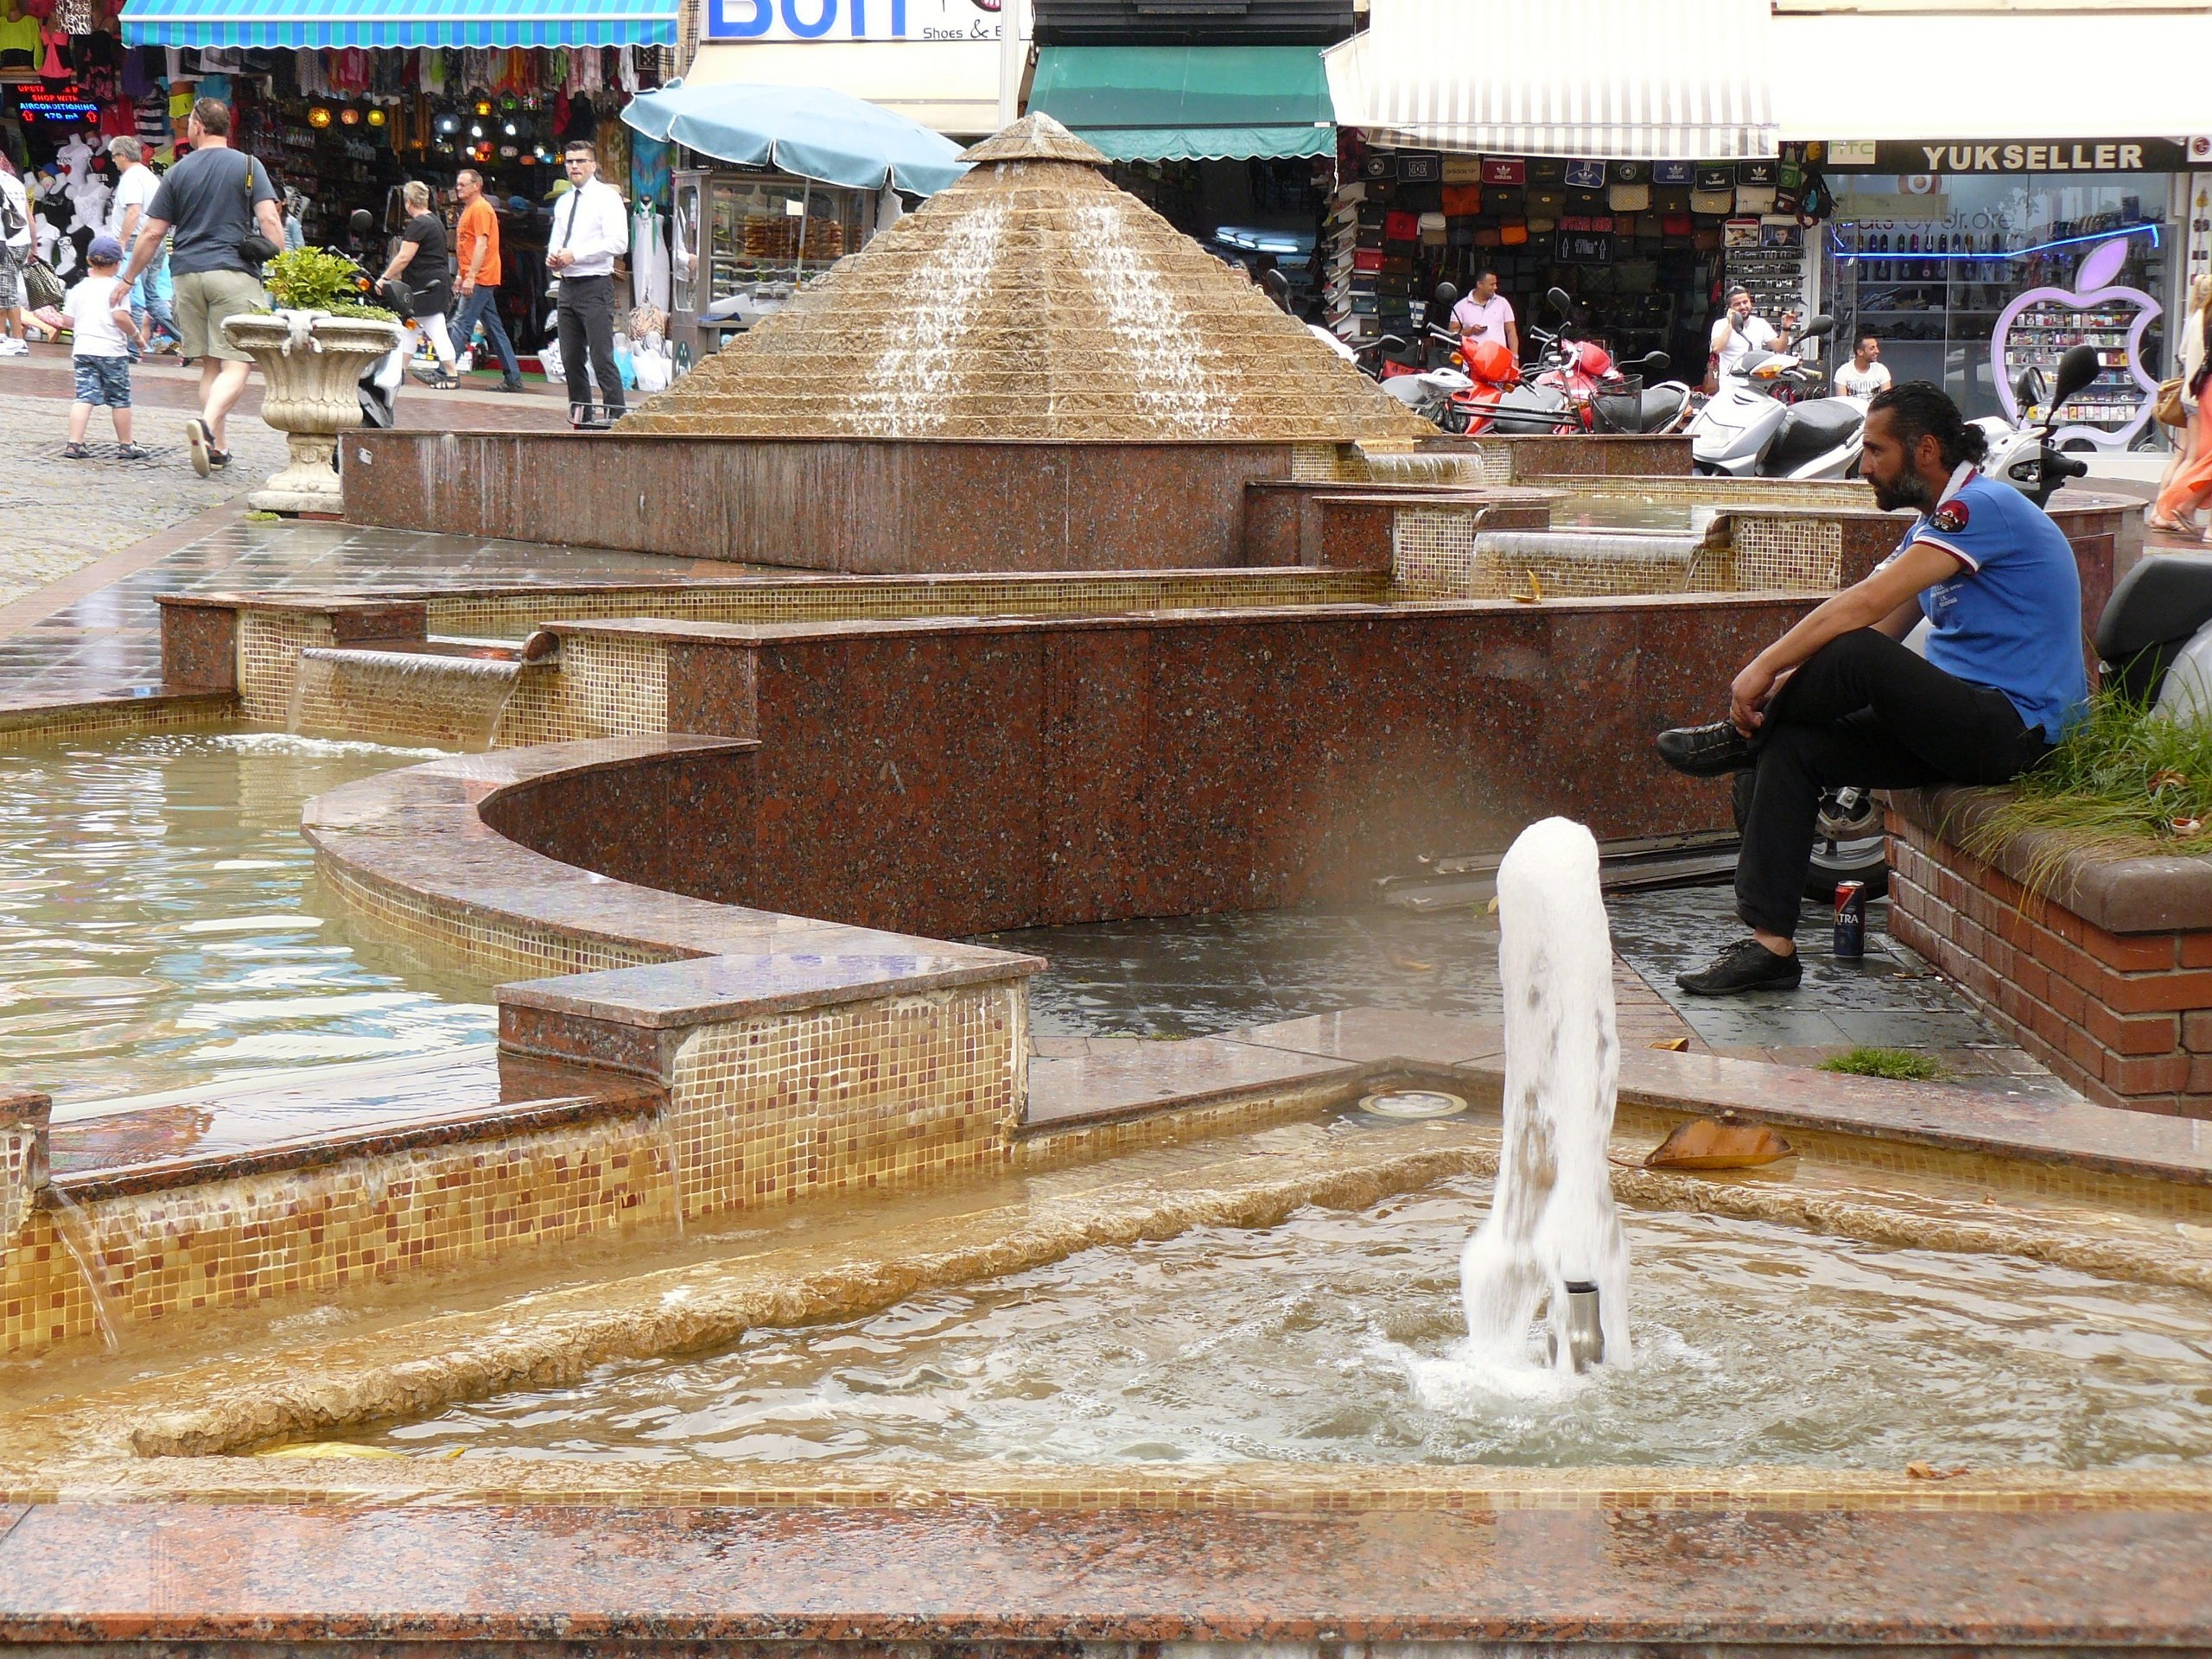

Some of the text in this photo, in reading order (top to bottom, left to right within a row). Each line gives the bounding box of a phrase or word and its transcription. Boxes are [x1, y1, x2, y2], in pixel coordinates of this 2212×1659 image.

[923, 27, 963, 39] Shoes
[970, 18, 989, 39] &
[19, 102, 98, 111] AIRCONDITIONING
[1923, 143, 2143, 171] YUKSELLER
